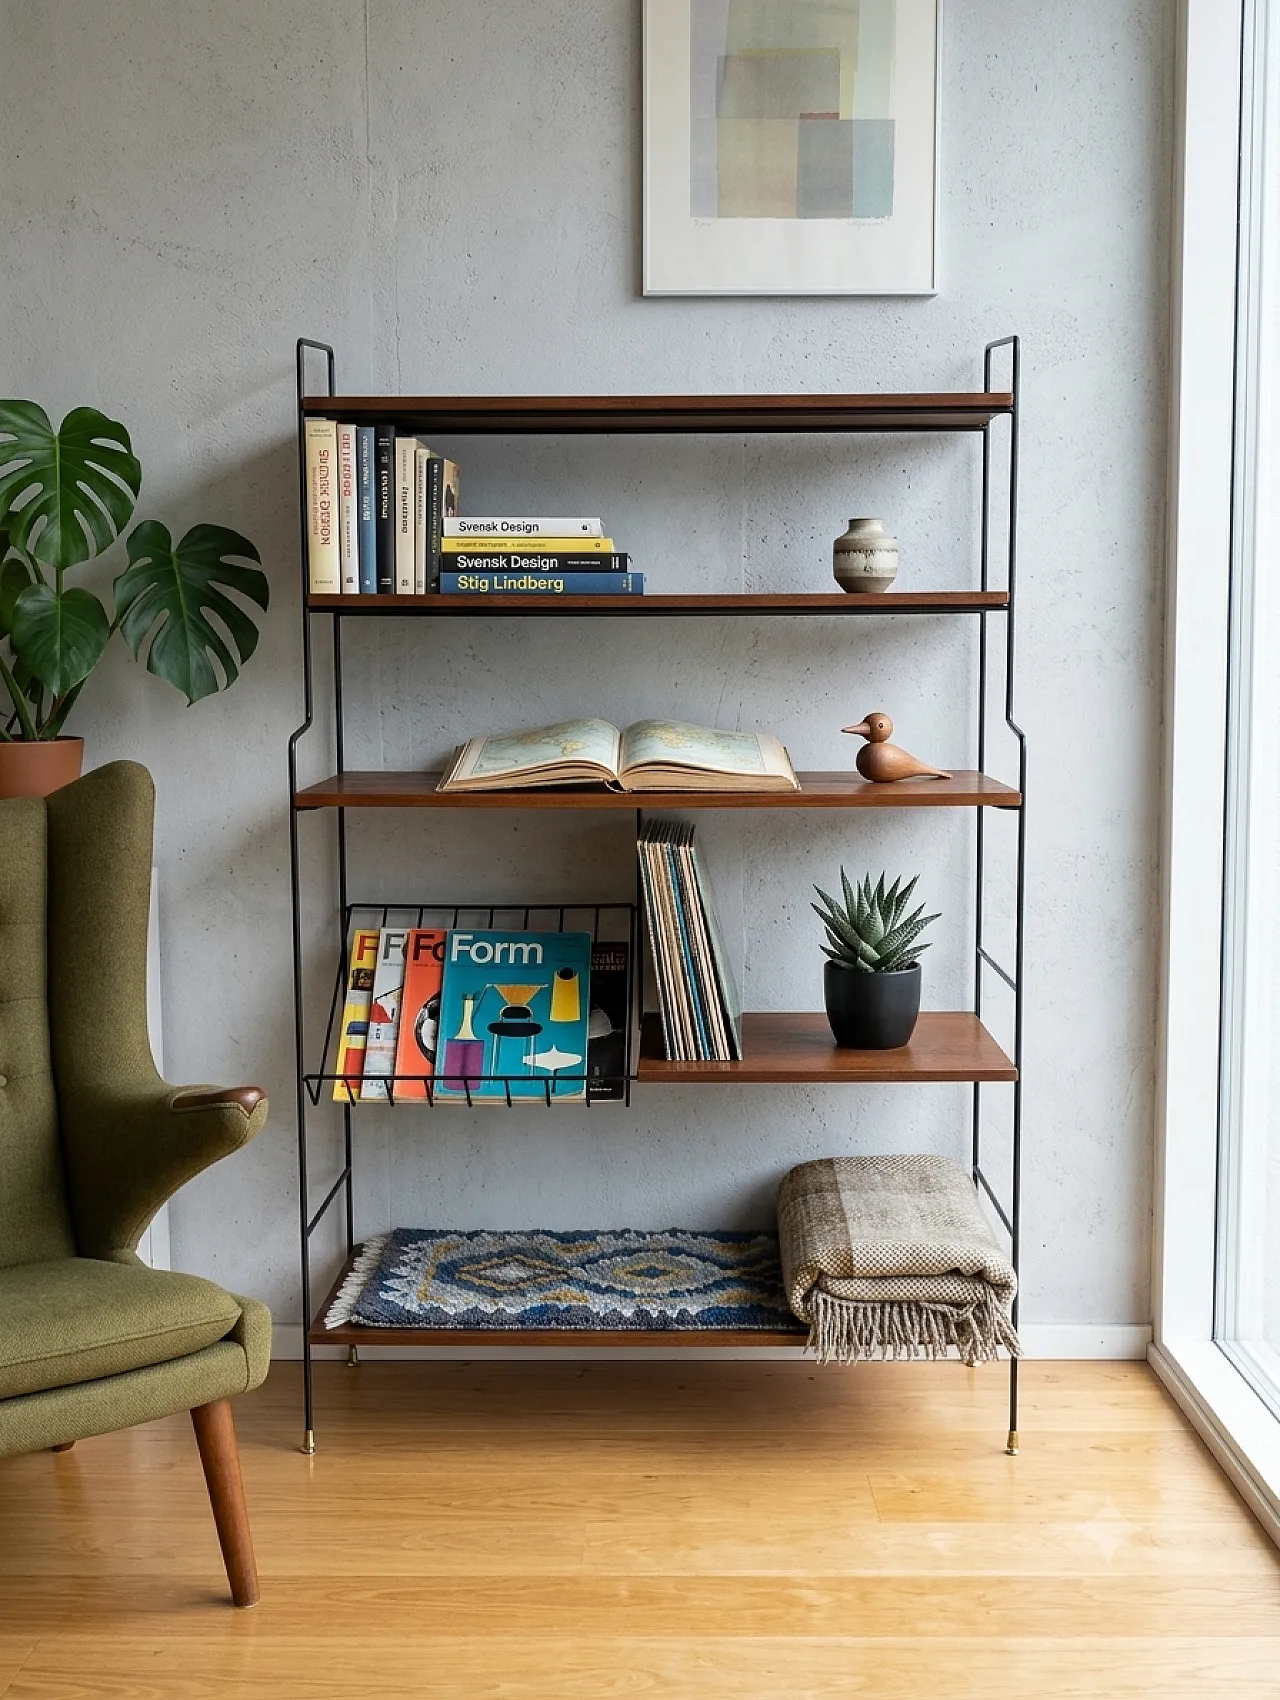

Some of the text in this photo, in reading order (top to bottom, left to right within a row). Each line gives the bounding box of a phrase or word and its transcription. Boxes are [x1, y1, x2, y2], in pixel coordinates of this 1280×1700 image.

[459, 521, 540, 534] Svensk Design
[457, 555, 558, 571] Svensk Design
[457, 575, 564, 593] Stig Lindberg
[451, 933, 543, 964] Form
